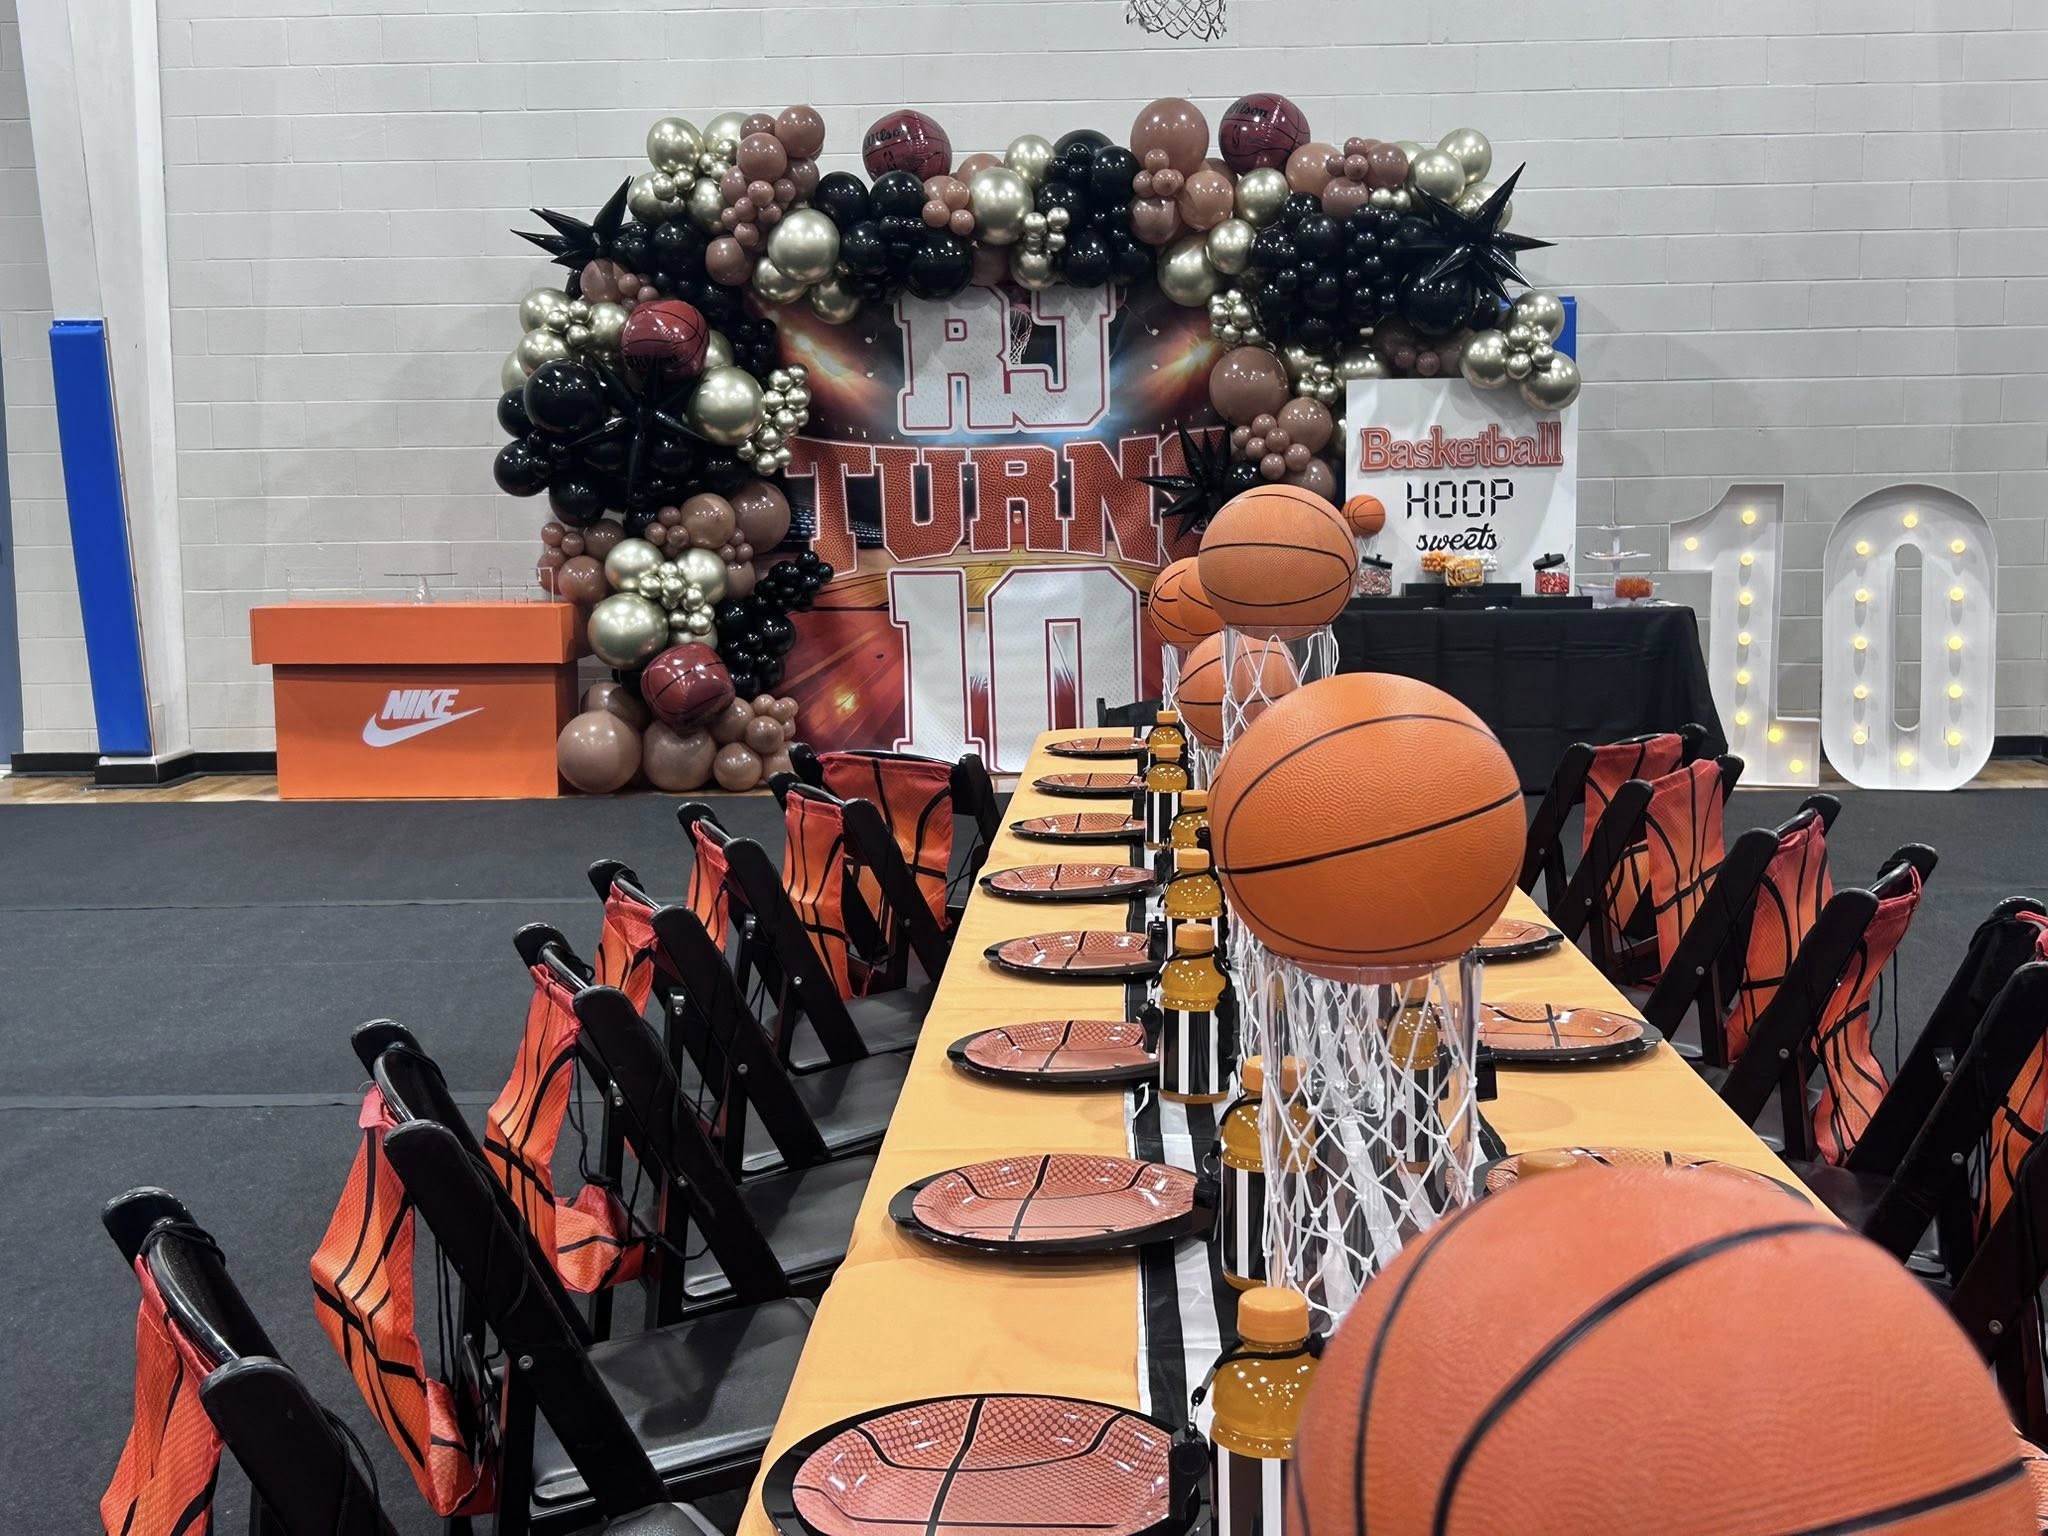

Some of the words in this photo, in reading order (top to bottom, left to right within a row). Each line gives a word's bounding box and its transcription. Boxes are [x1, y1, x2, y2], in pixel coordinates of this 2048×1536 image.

[894, 283, 1117, 434] RJ
[1359, 421, 1564, 472] Basketball
[1406, 478, 1514, 519] HOOP
[1416, 523, 1498, 551] sweets
[1668, 482, 1998, 791] 10
[888, 563, 1142, 772] 10
[381, 688, 459, 720] NIKE
